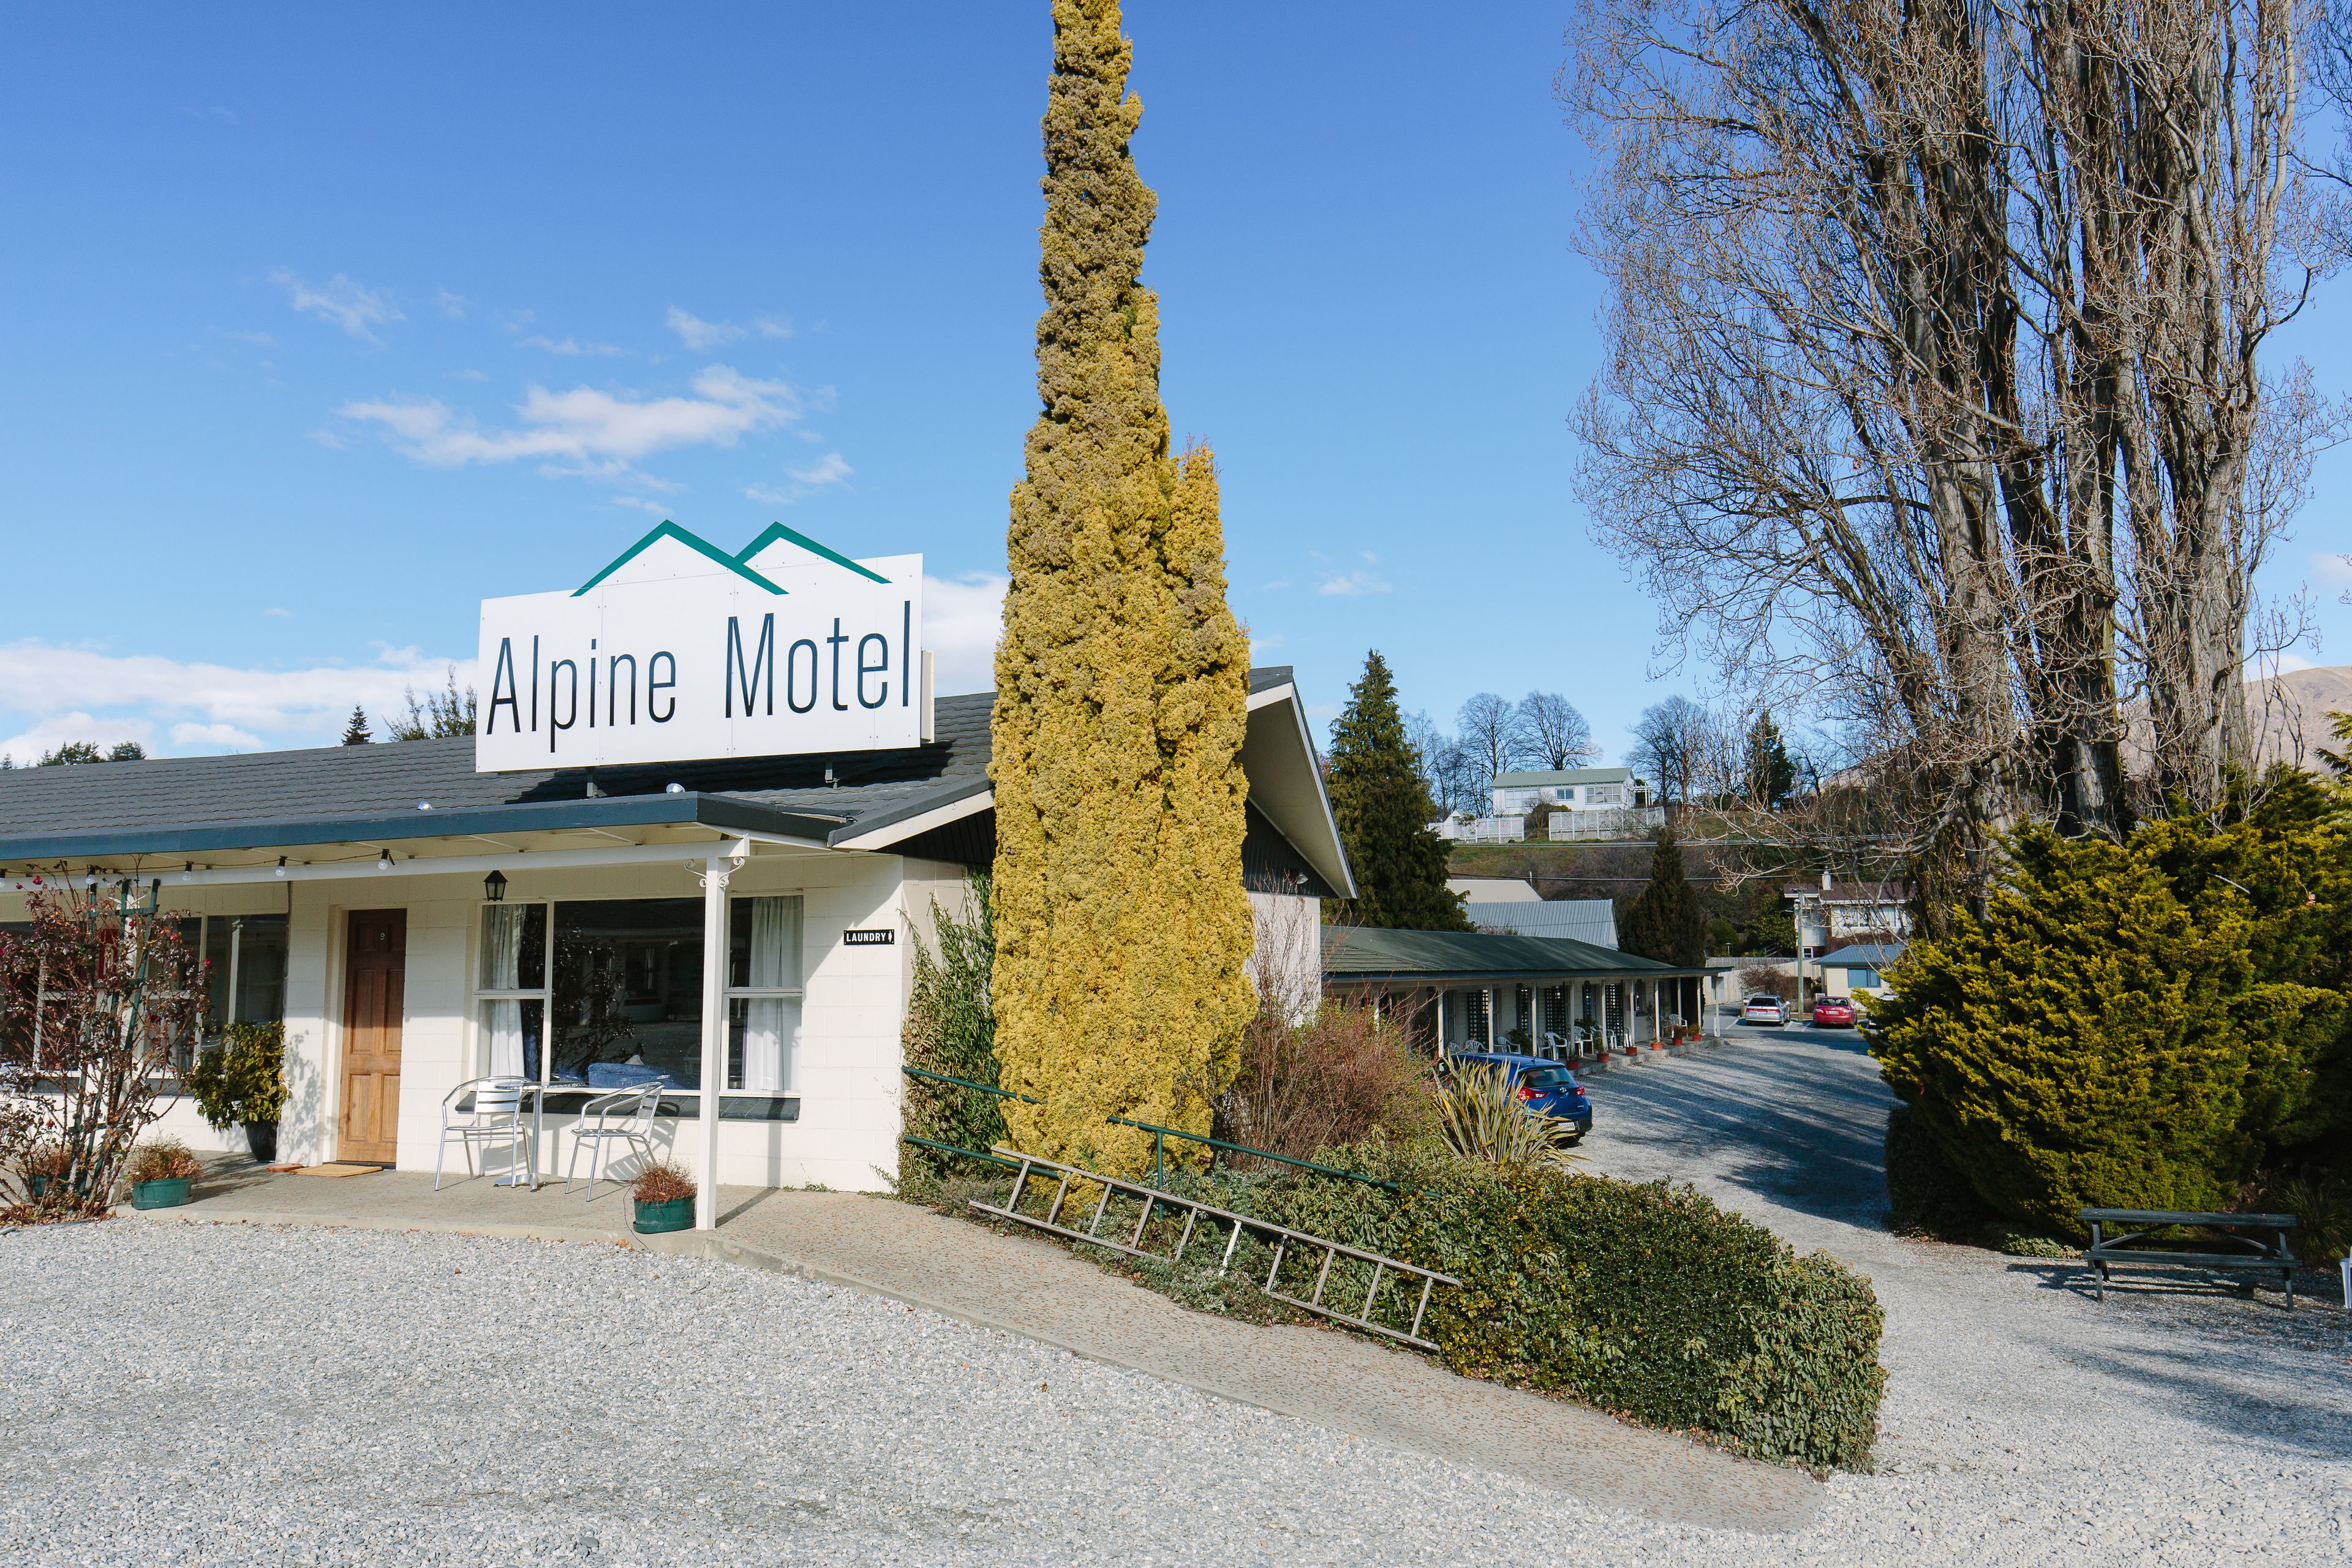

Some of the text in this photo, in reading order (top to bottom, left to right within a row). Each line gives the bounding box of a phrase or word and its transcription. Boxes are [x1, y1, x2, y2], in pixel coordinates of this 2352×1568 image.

[486, 600, 911, 753] Alpine Motel
[846, 932, 886, 942] LAUNDRY
